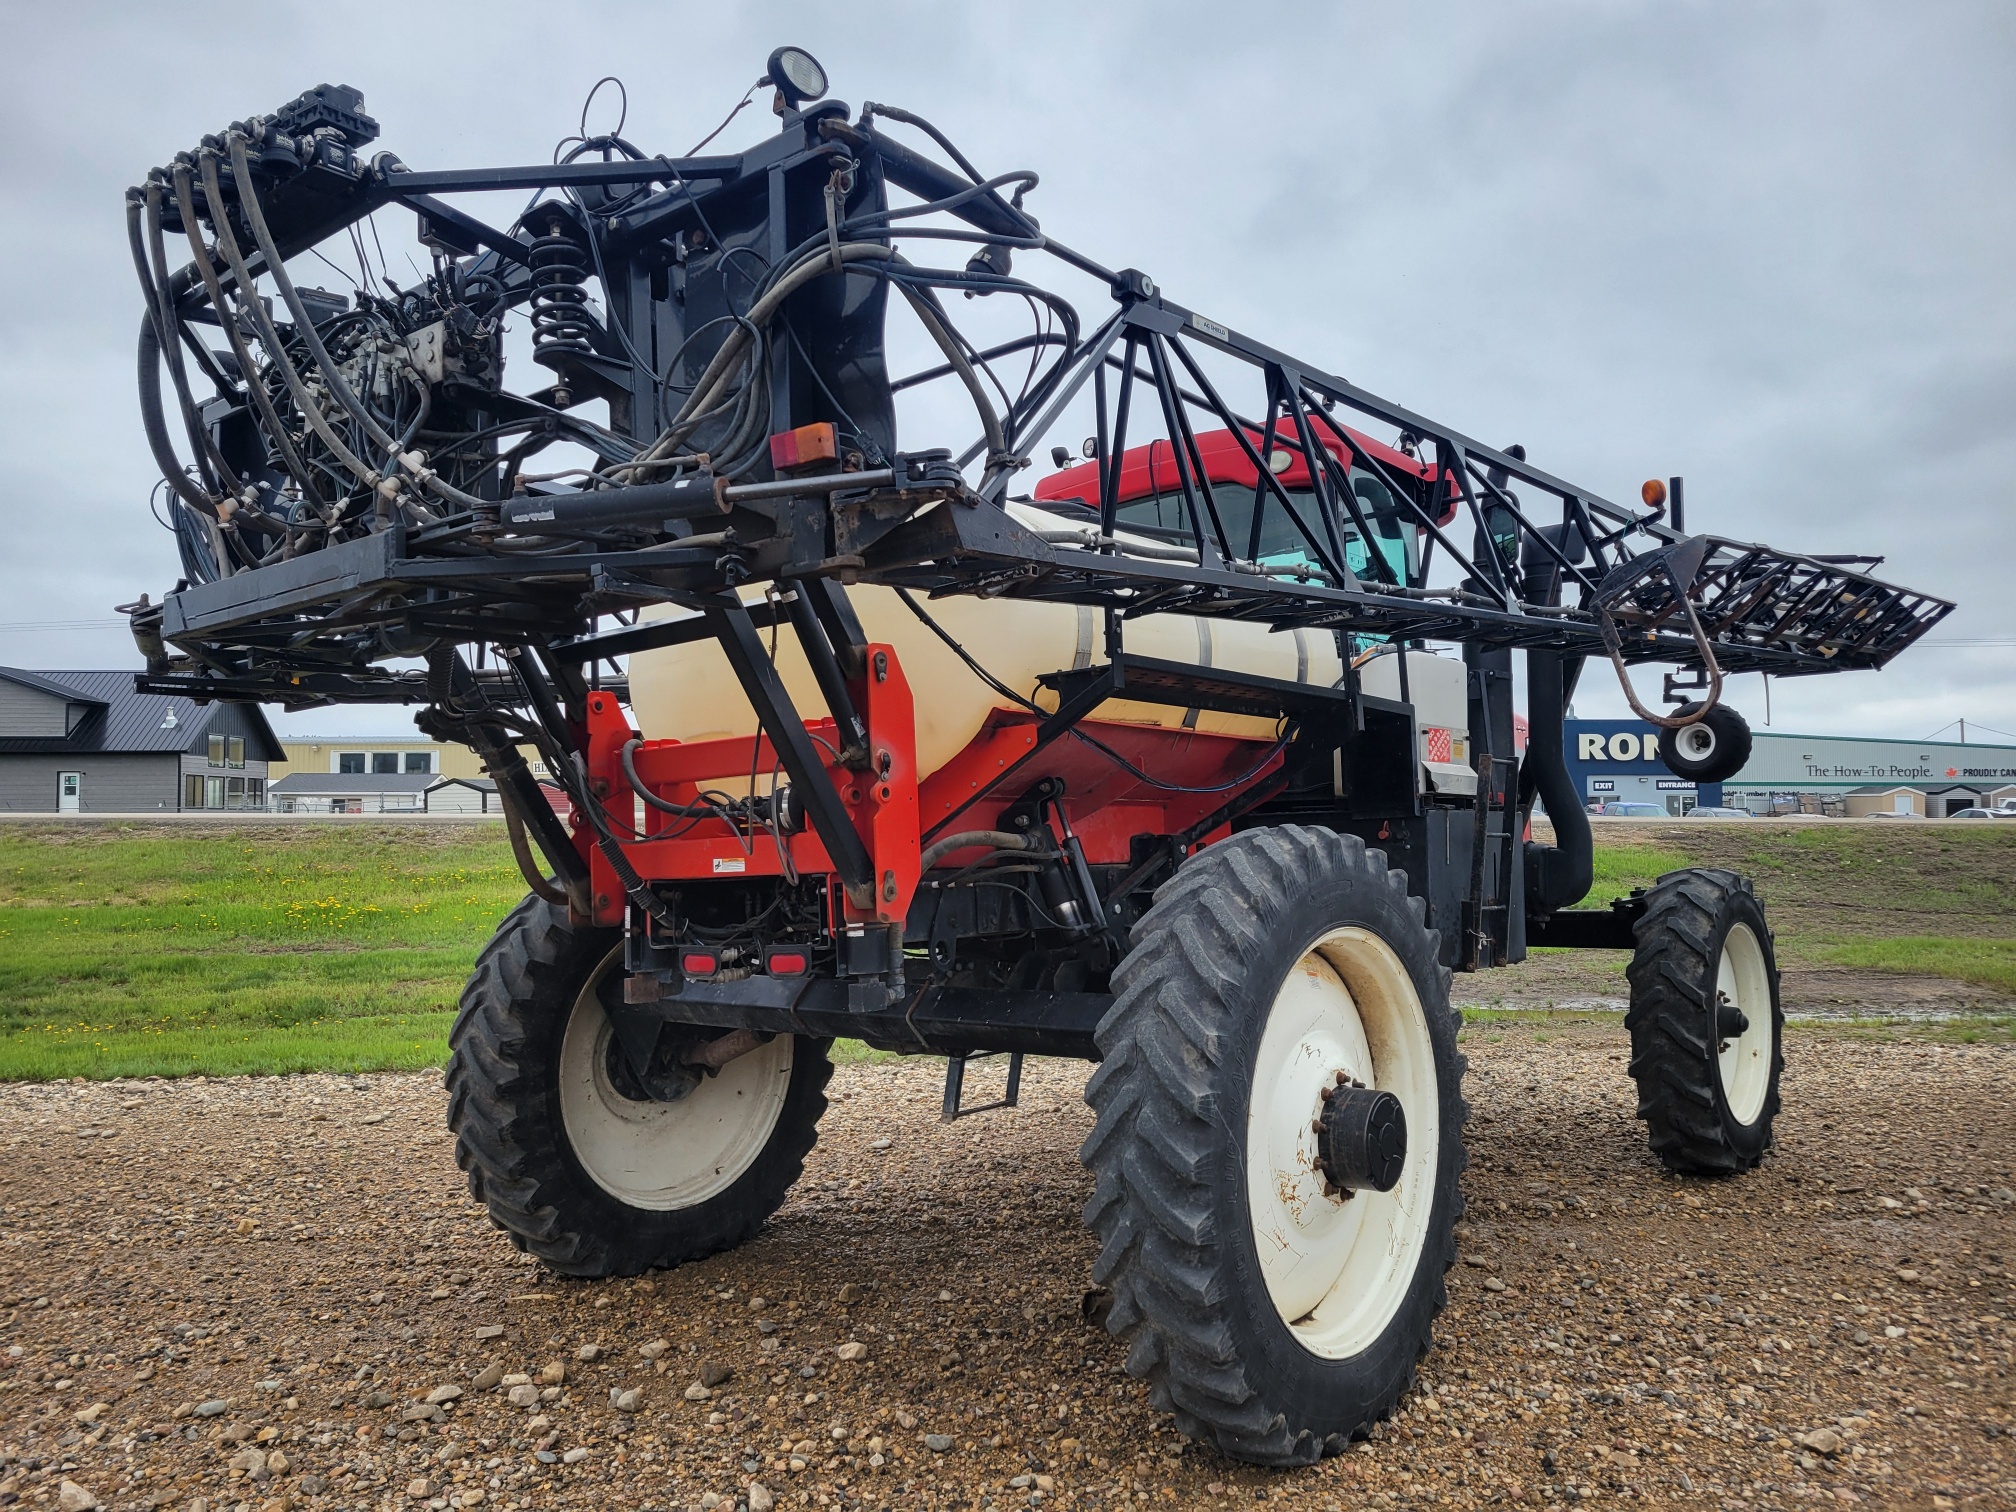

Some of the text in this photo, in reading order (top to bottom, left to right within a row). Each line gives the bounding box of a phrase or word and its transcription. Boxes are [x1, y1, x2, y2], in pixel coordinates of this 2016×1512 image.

[1805, 765, 1934, 779] The How-To People.
[1963, 768, 1997, 777] PROUDLY
[1224, 1141, 1239, 1204] LUG
